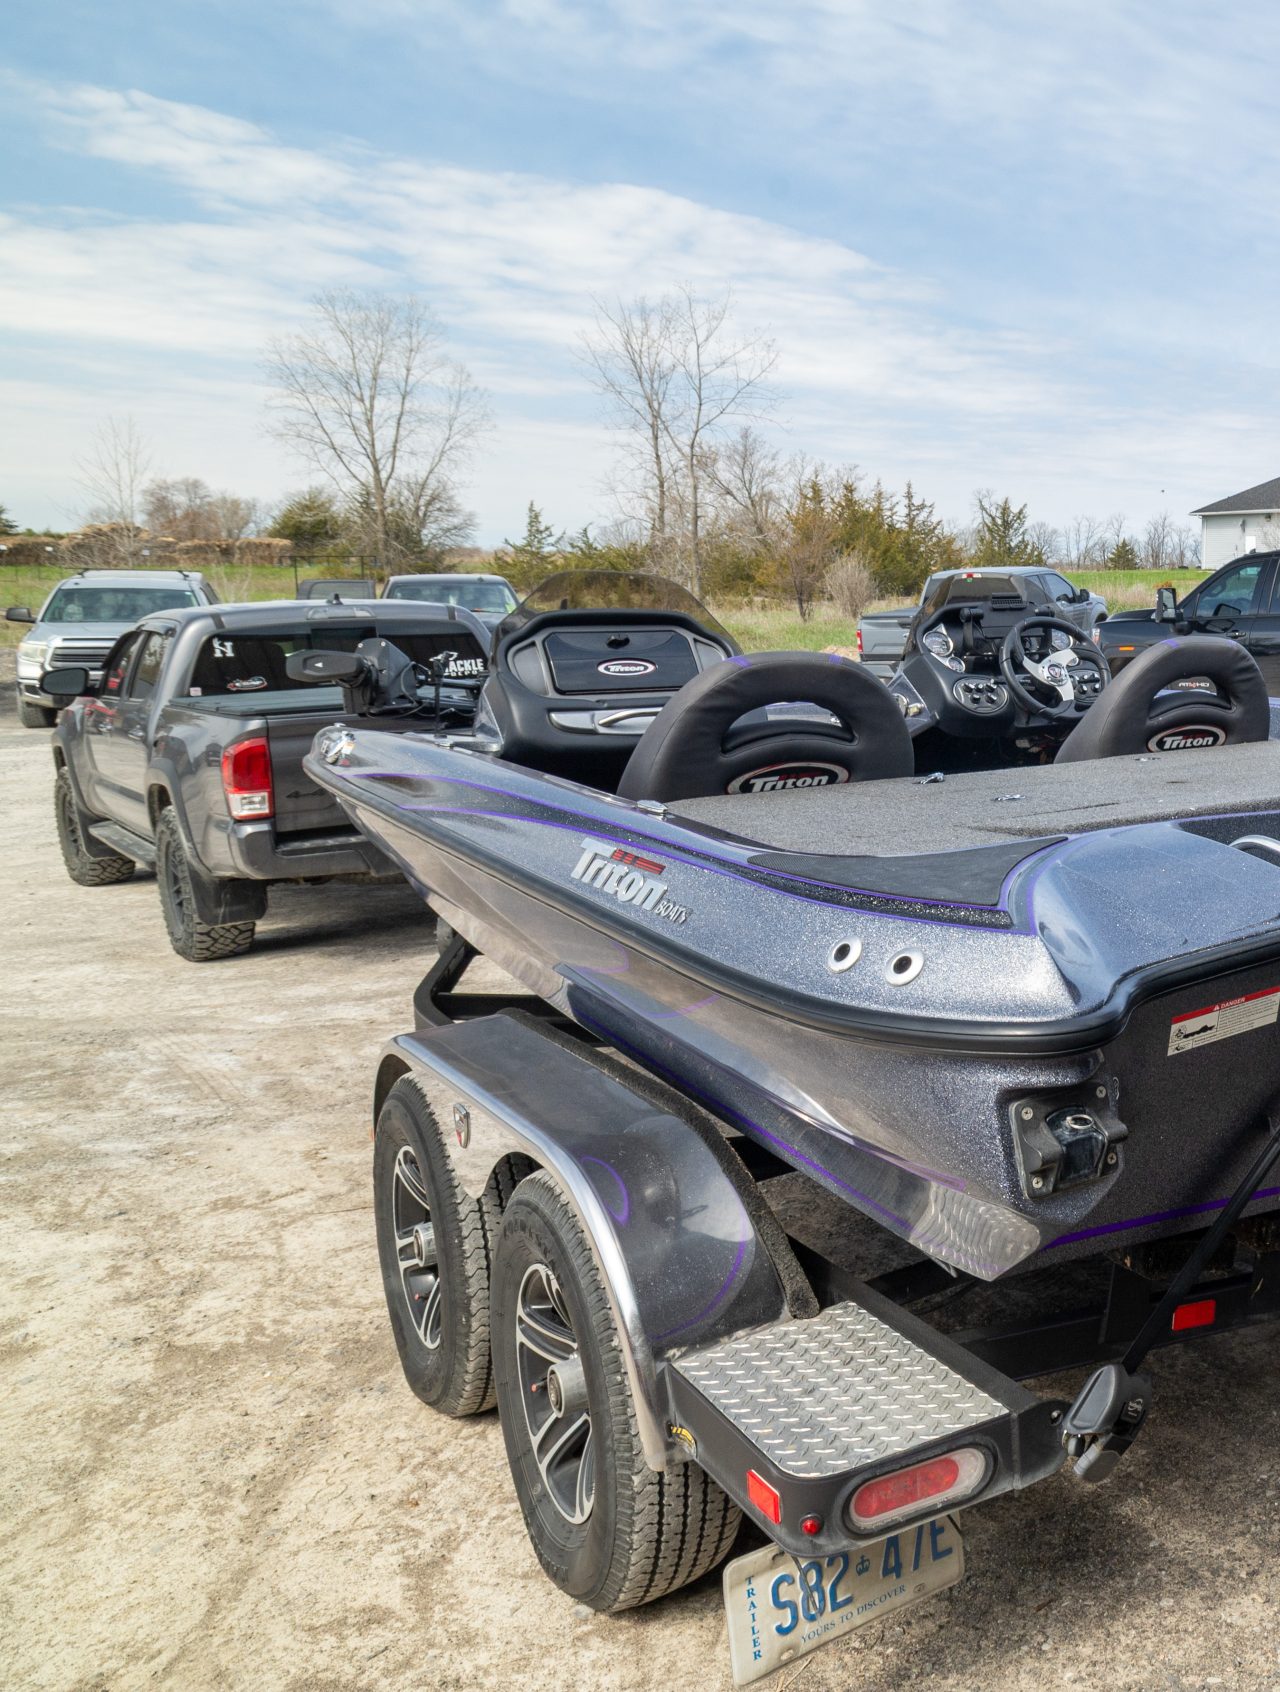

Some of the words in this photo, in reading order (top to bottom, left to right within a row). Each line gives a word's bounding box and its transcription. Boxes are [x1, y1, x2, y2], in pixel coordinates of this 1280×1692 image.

[444, 658, 484, 672] ACKLE
[1162, 735, 1214, 750] Triton
[749, 775, 829, 793] Triton
[570, 837, 668, 911] Triton
[655, 899, 689, 924] BOATS
[1220, 997, 1246, 1010] DANGER
[769, 1551, 855, 1636] S82
[745, 1575, 762, 1661] TRAILER
[800, 1618, 836, 1643] YOURS
[840, 1610, 854, 1624] TO
[856, 1584, 907, 1615] DISCOVER
